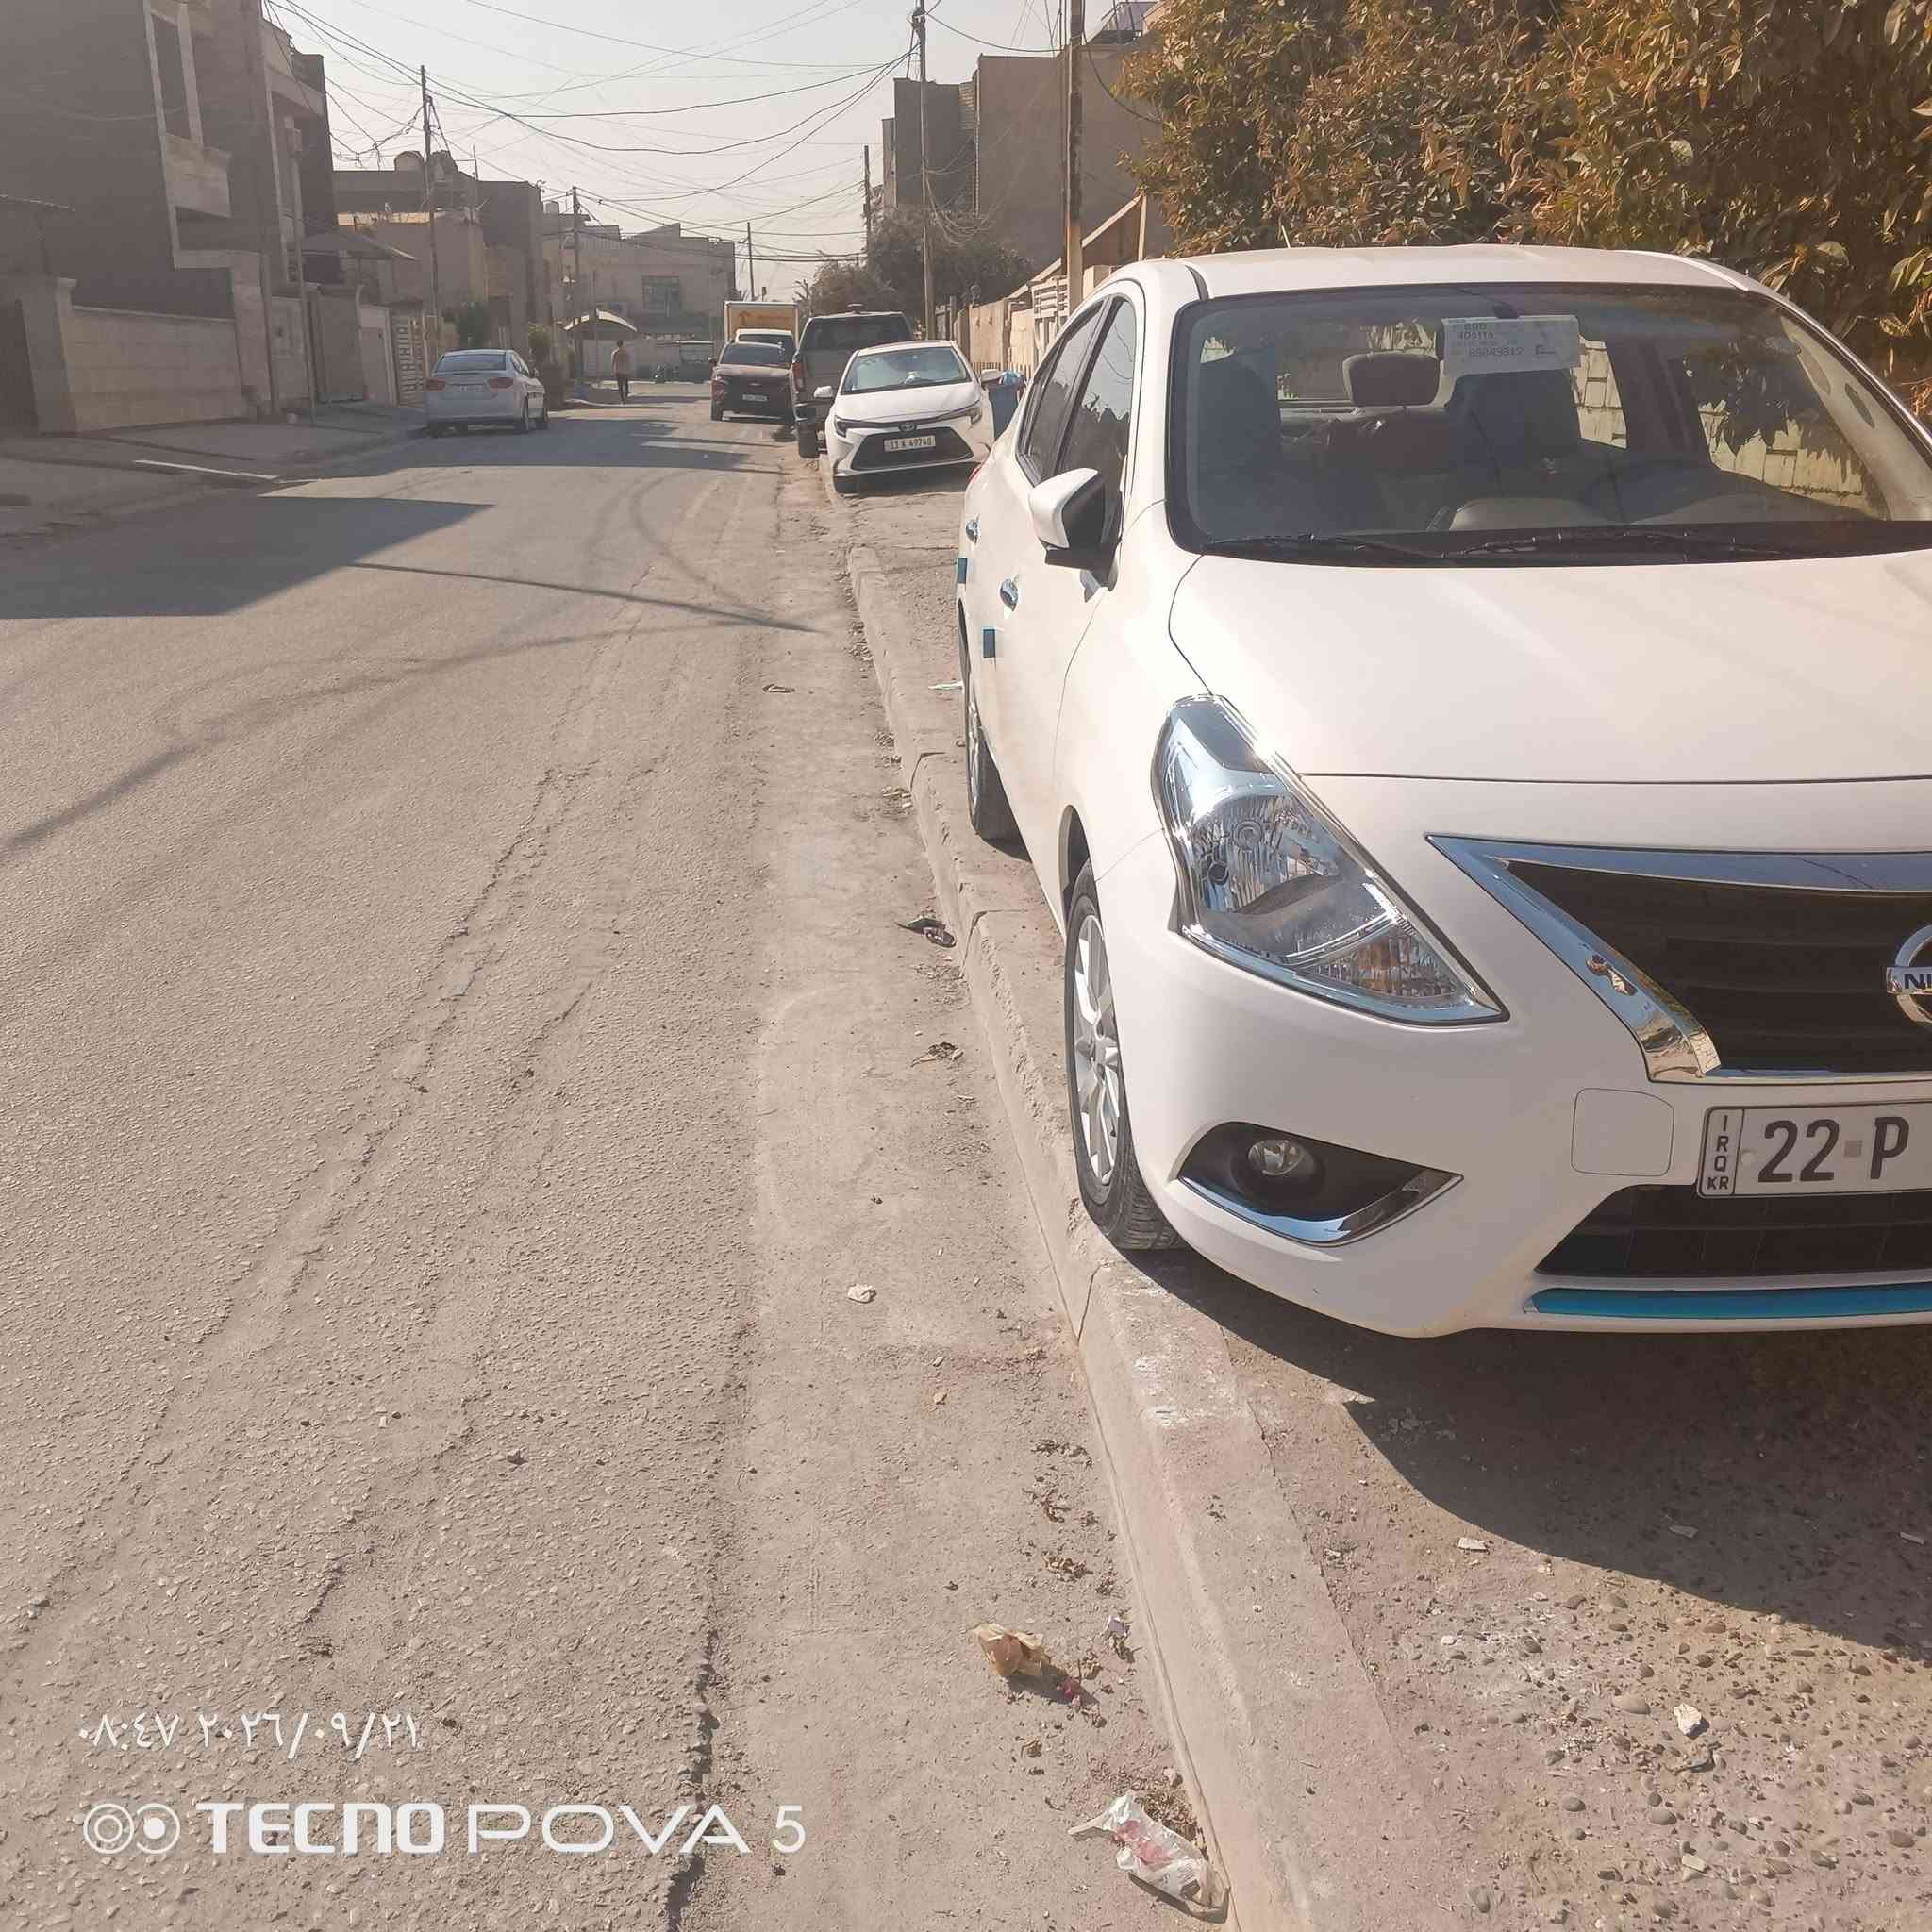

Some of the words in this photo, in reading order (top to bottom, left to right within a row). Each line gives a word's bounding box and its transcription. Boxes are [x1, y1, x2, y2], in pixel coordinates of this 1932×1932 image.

[1757, 1119, 1840, 1183] 22
[1870, 1116, 1910, 1179] P
[1707, 1175, 1730, 1191] KR
